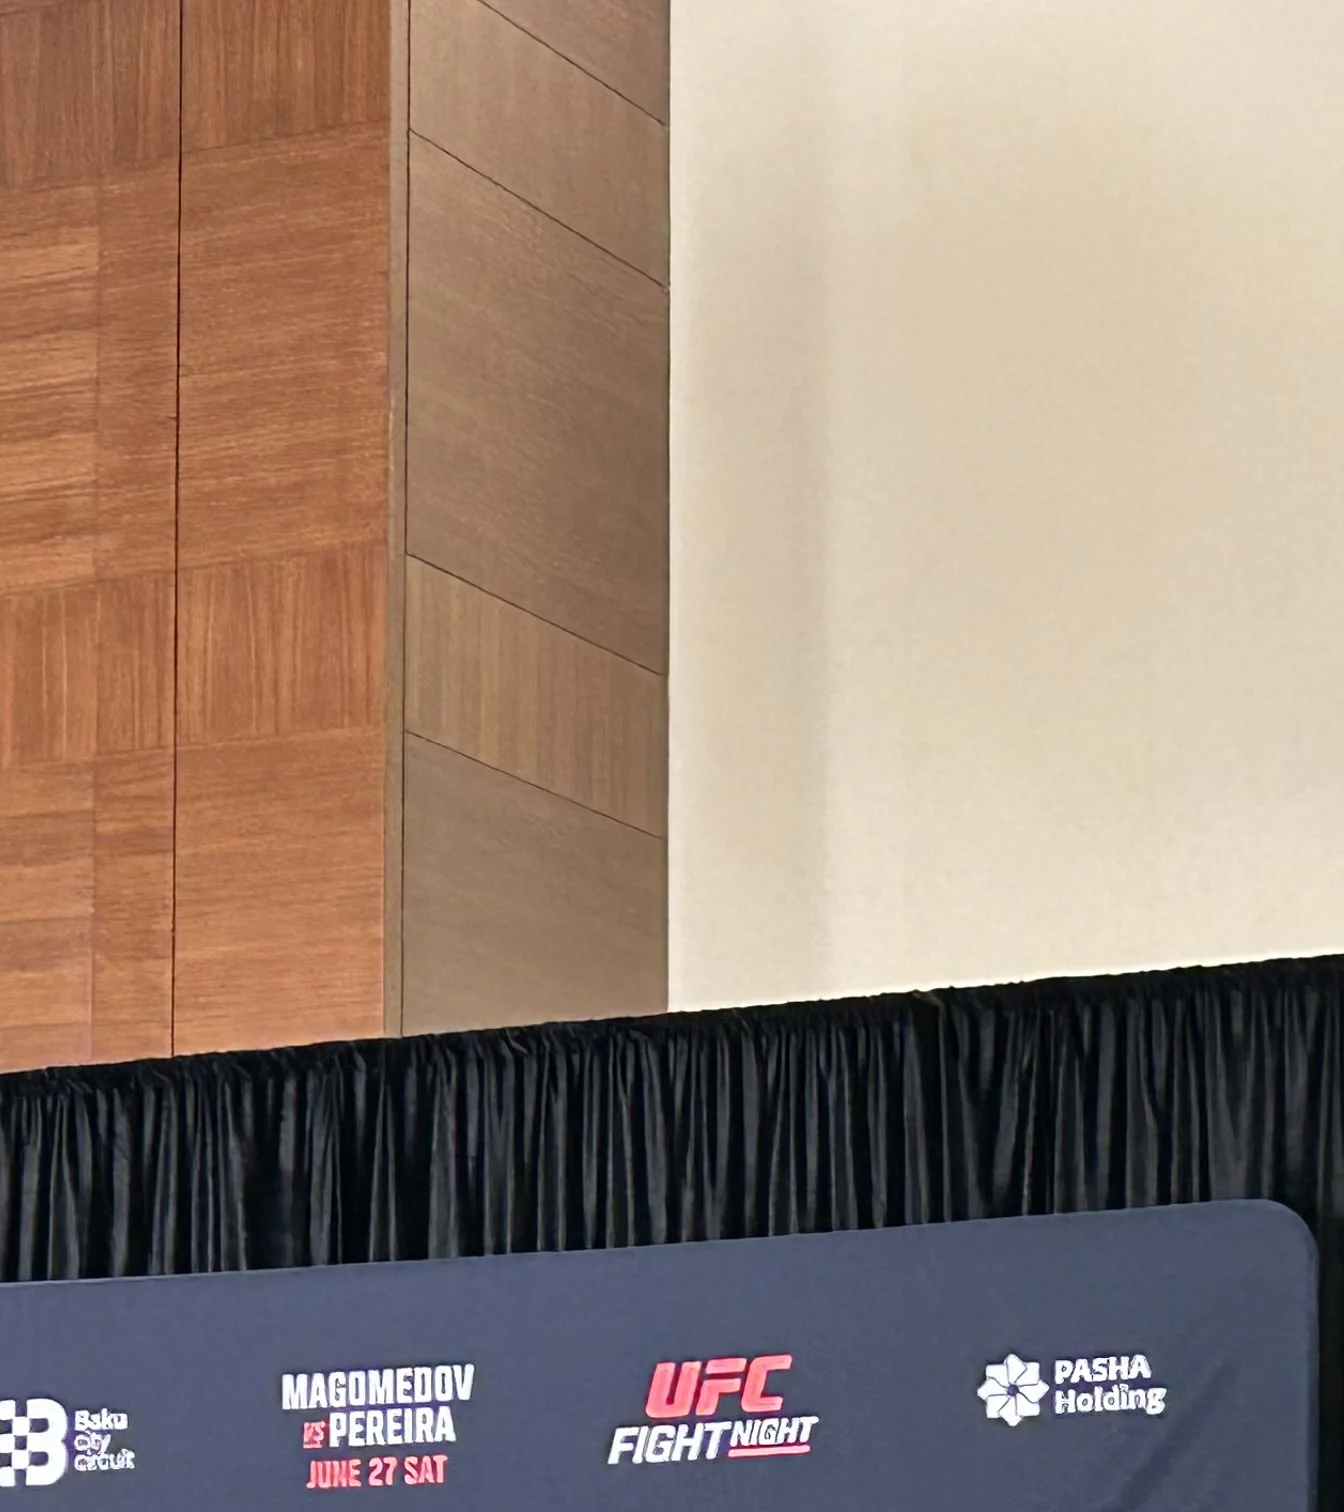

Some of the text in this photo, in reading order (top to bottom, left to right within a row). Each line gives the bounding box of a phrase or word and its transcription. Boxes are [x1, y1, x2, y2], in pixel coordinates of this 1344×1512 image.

[282, 1364, 474, 1410] MAGOMEDOV
[644, 1354, 793, 1420] UFC
[1054, 1354, 1153, 1384] PASHA
[1054, 1383, 1167, 1416] Holding
[329, 1407, 455, 1447] PEREIRA
[608, 1415, 819, 1465] FIGHT NIGHT
[306, 1455, 448, 1489] JUNE 27 SAT
